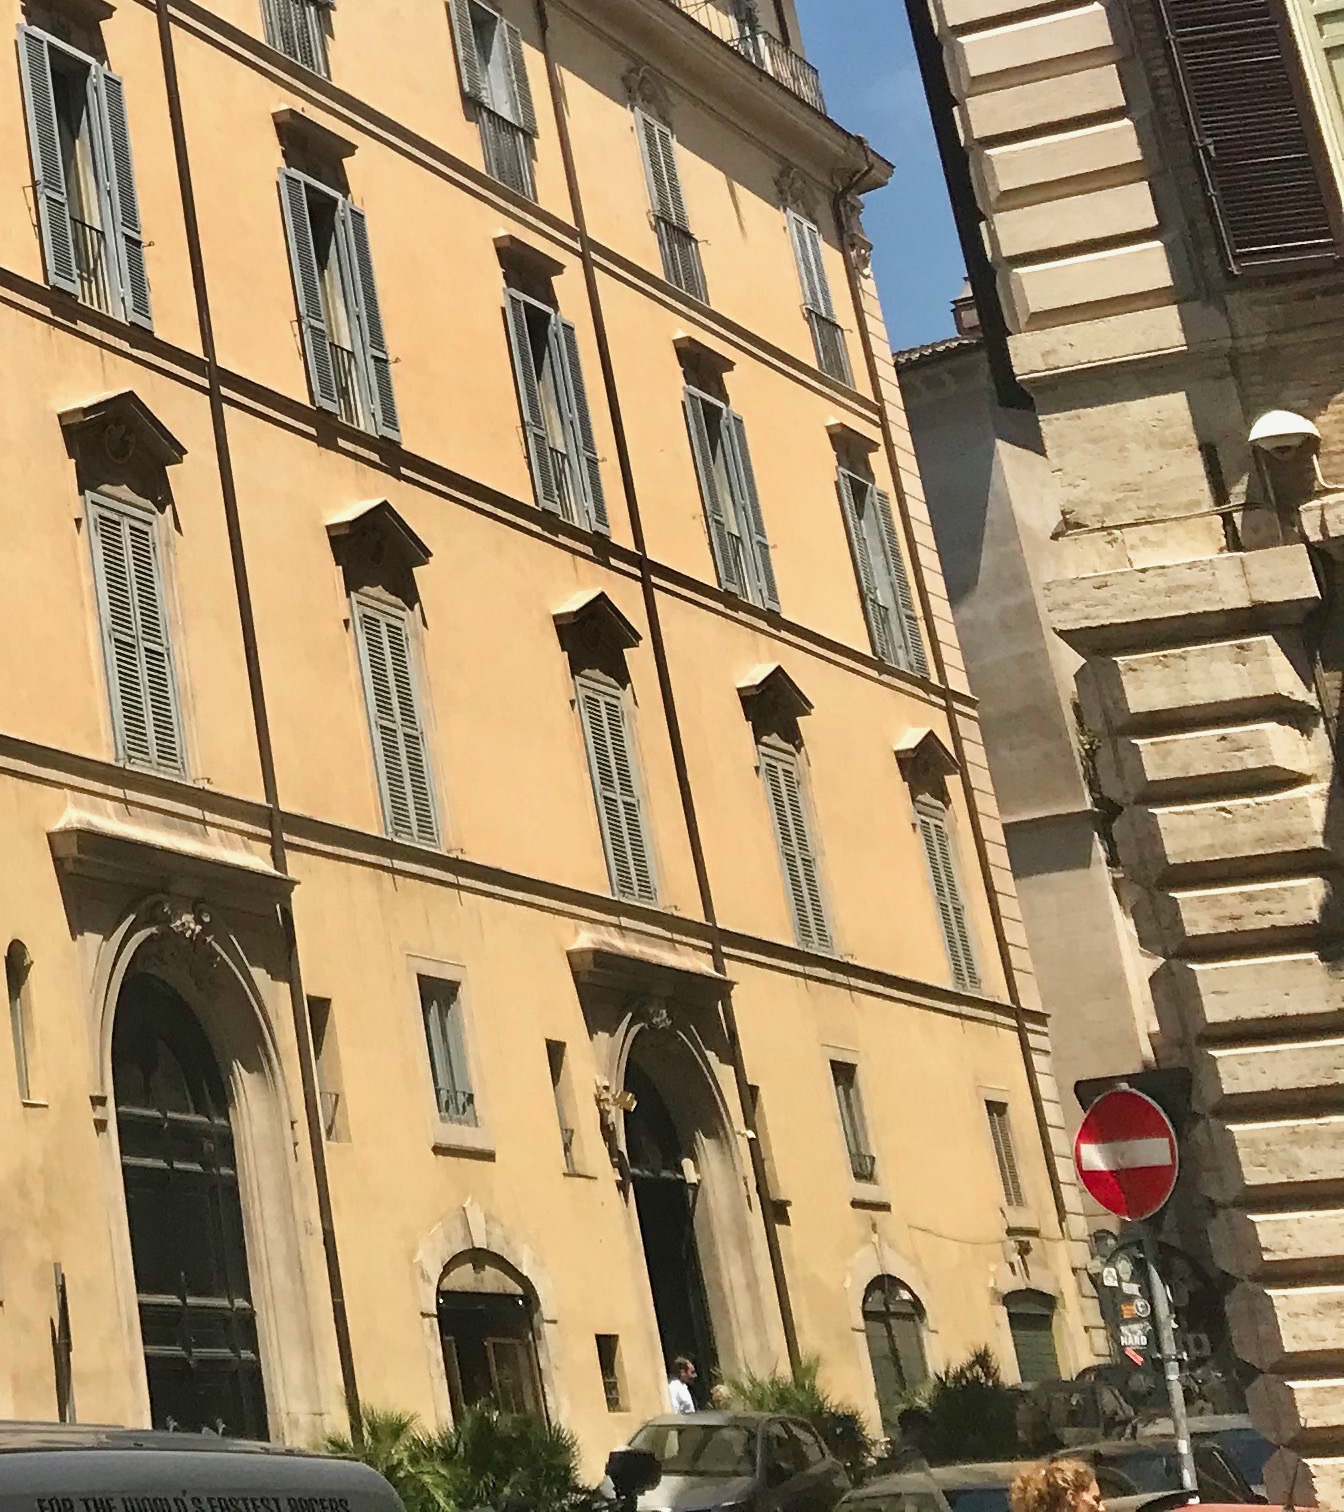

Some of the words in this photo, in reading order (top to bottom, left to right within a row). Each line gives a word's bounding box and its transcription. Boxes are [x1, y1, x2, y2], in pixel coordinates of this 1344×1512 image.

[36, 1496, 76, 1512] FOR
[79, 1496, 118, 1512] THE
[206, 1496, 282, 1512] FASTEST
